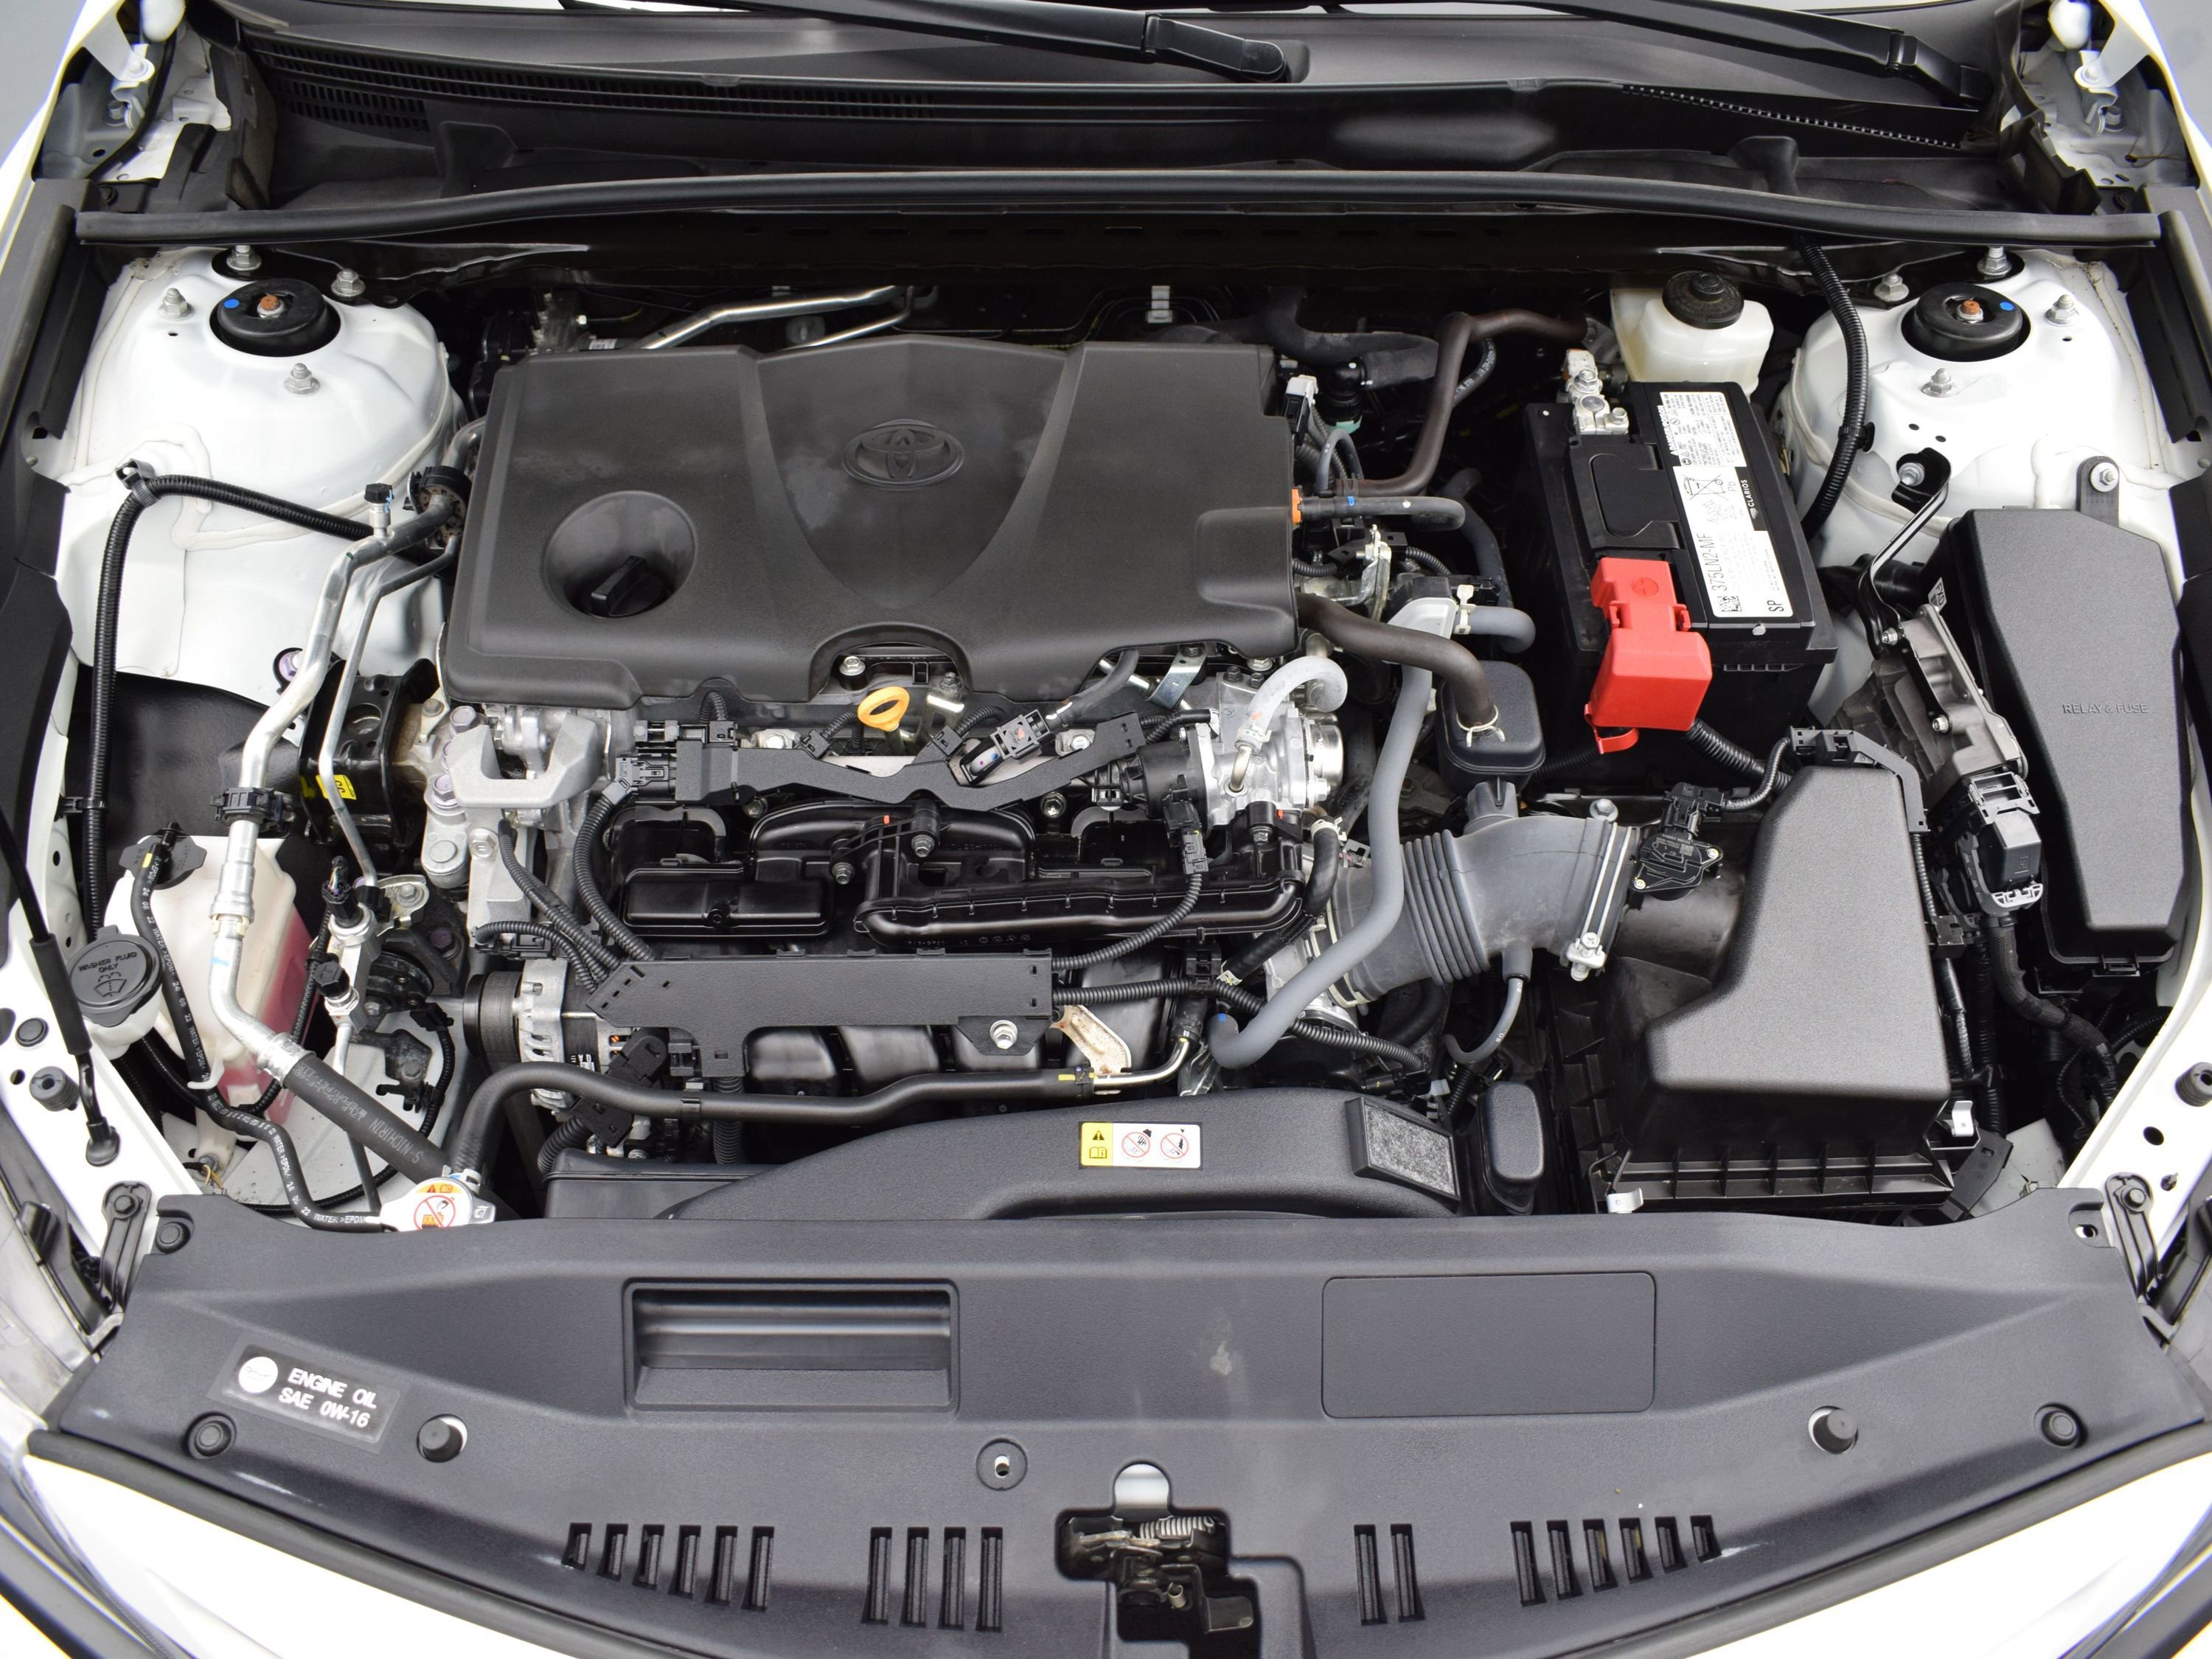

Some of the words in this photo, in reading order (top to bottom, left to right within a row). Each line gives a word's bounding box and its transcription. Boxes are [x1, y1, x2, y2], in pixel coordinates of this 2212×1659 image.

[1740, 479, 1754, 507] CLARIOS
[1697, 533, 1728, 591] 375LN2-MF
[1767, 600, 1784, 613] SP
[2062, 703, 2101, 714] RELAY
[2105, 704, 2112, 714] &
[2117, 703, 2149, 714] FUSE
[78, 958, 111, 972] WASHER
[115, 952, 137, 962] FLUID
[98, 964, 119, 973] ONLY
[147, 917, 155, 925] 22
[153, 928, 166, 950] WATER
[184, 1014, 192, 1023] 22
[273, 1134, 285, 1155] WATER
[286, 1181, 294, 1192] 24
[301, 1207, 311, 1216] 22
[313, 1213, 338, 1224] WATER
[288, 1367, 347, 1399] ENGINE
[352, 1388, 378, 1409] OIL
[278, 1388, 314, 1410] SAE
[320, 1400, 370, 1427] 0W-16
